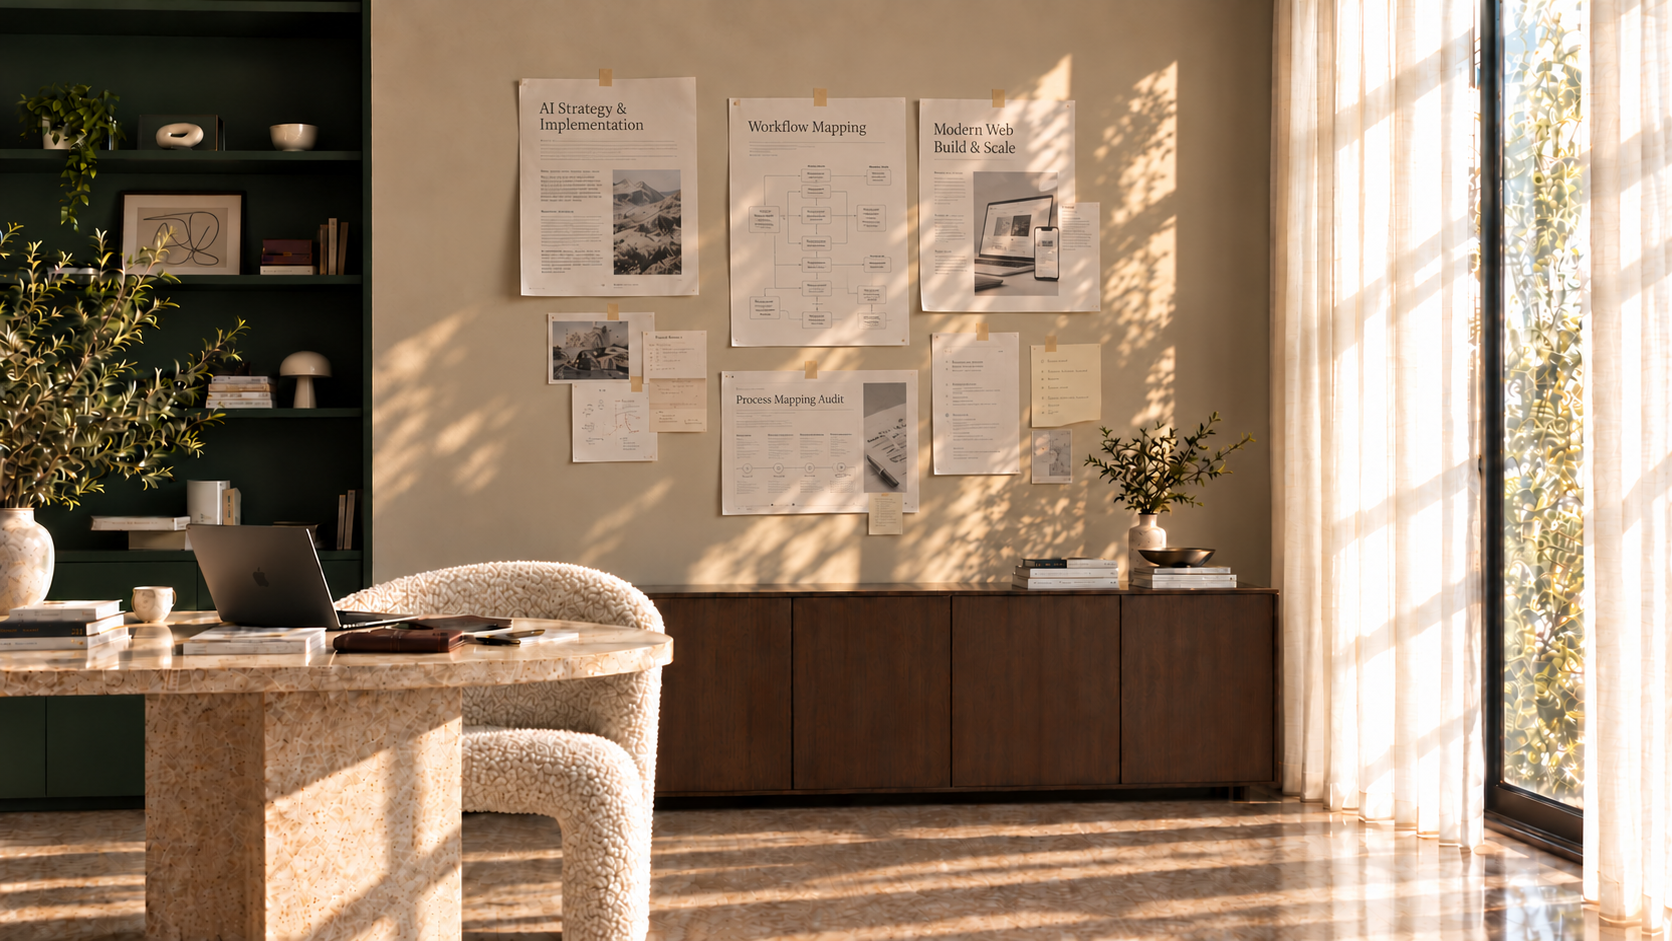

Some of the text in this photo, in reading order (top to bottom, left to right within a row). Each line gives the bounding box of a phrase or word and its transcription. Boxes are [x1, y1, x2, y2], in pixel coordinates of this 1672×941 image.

[539, 102, 627, 117] AI Strategy &
[539, 118, 644, 134] Implementation
[748, 120, 867, 136] Workflow Mapping
[934, 122, 1014, 136] Modern Web
[934, 140, 1016, 154] Build & Scale
[736, 394, 844, 407] Process Mapping Audit
